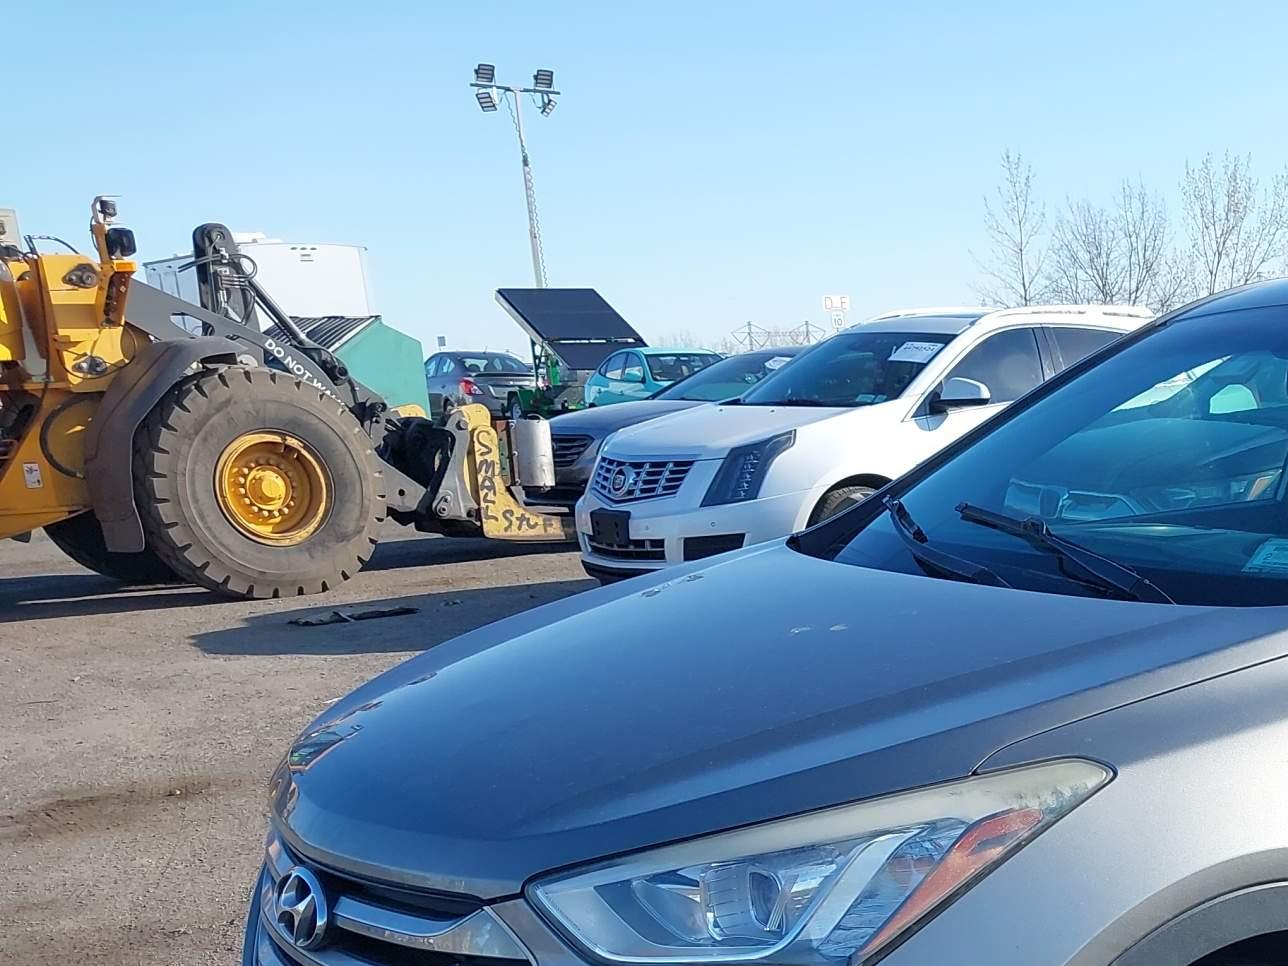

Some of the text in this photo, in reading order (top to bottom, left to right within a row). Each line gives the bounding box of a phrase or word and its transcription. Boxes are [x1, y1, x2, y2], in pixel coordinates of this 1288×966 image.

[264, 338, 284, 358] DO
[284, 355, 313, 381] NOT
[477, 429, 499, 522] SMALL
